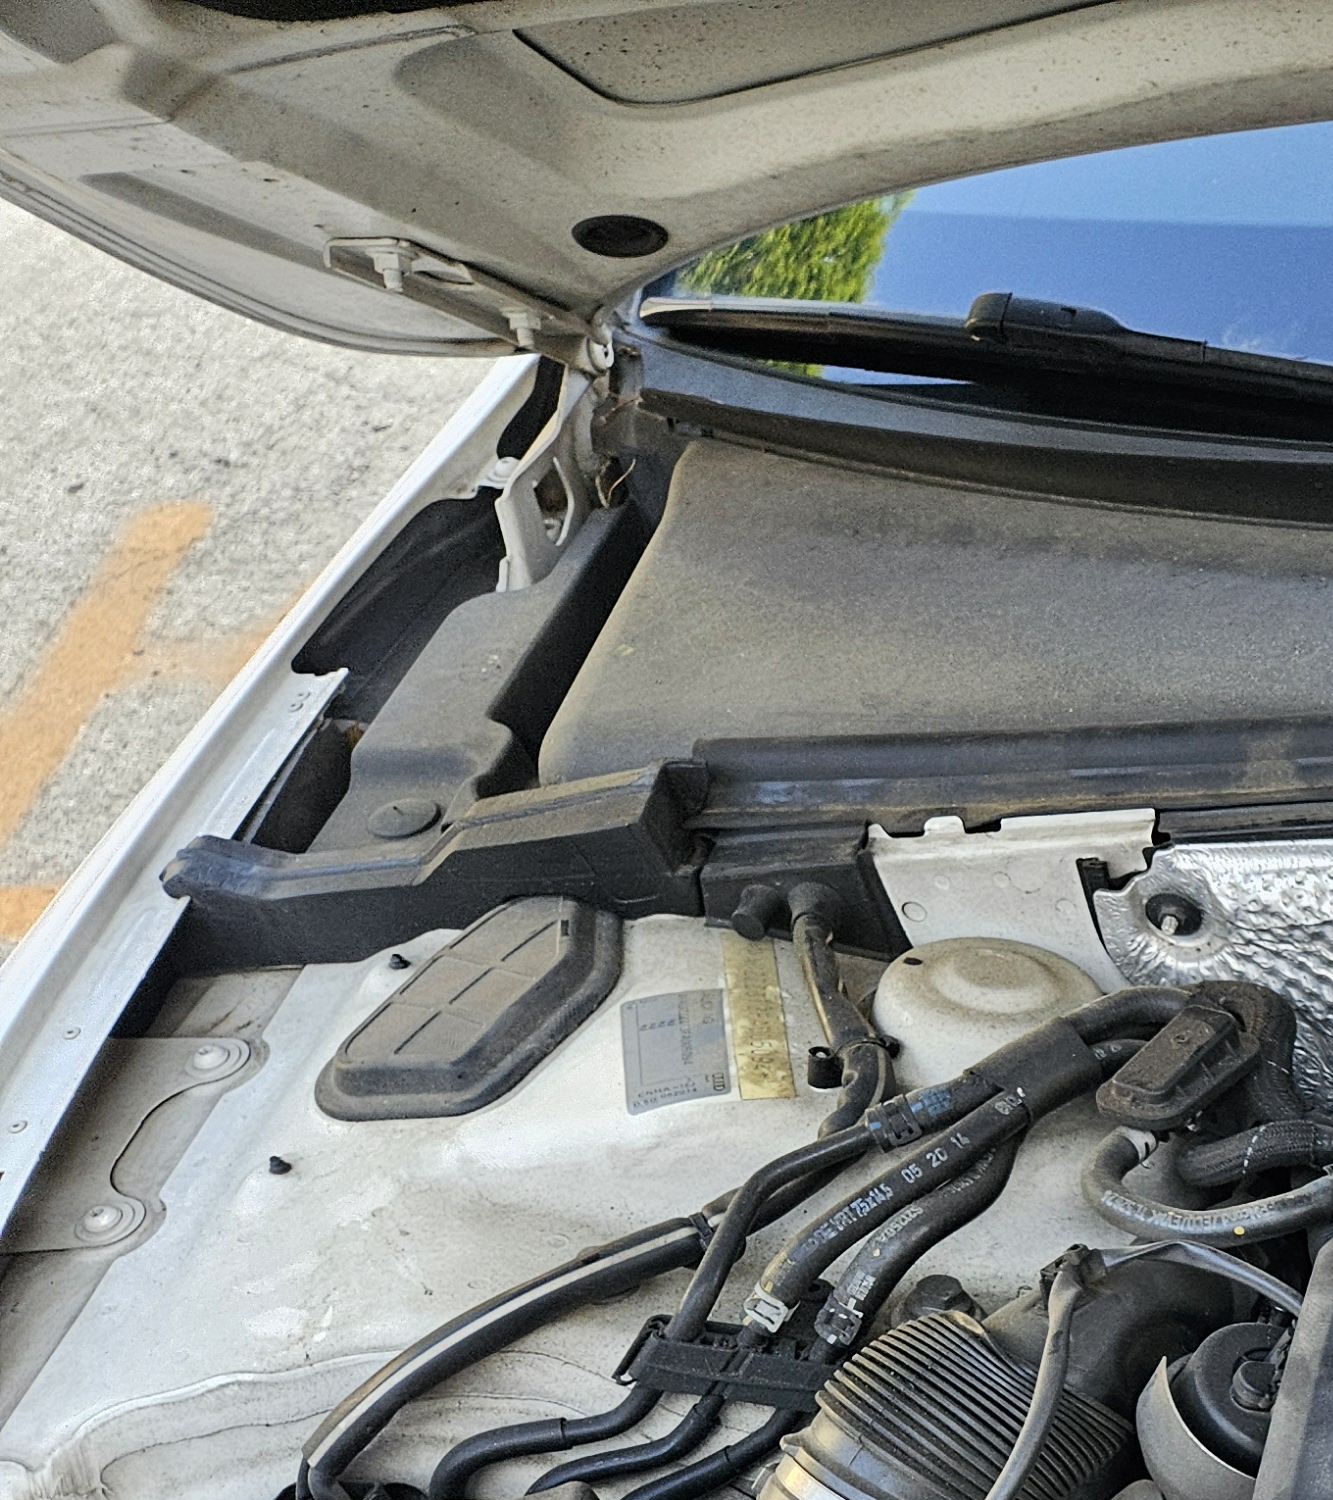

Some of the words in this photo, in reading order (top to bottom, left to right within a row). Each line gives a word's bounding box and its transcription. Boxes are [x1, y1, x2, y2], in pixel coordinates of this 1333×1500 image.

[901, 1163, 922, 1183] 05
[926, 1147, 948, 1168] 20
[951, 1133, 970, 1149] 14
